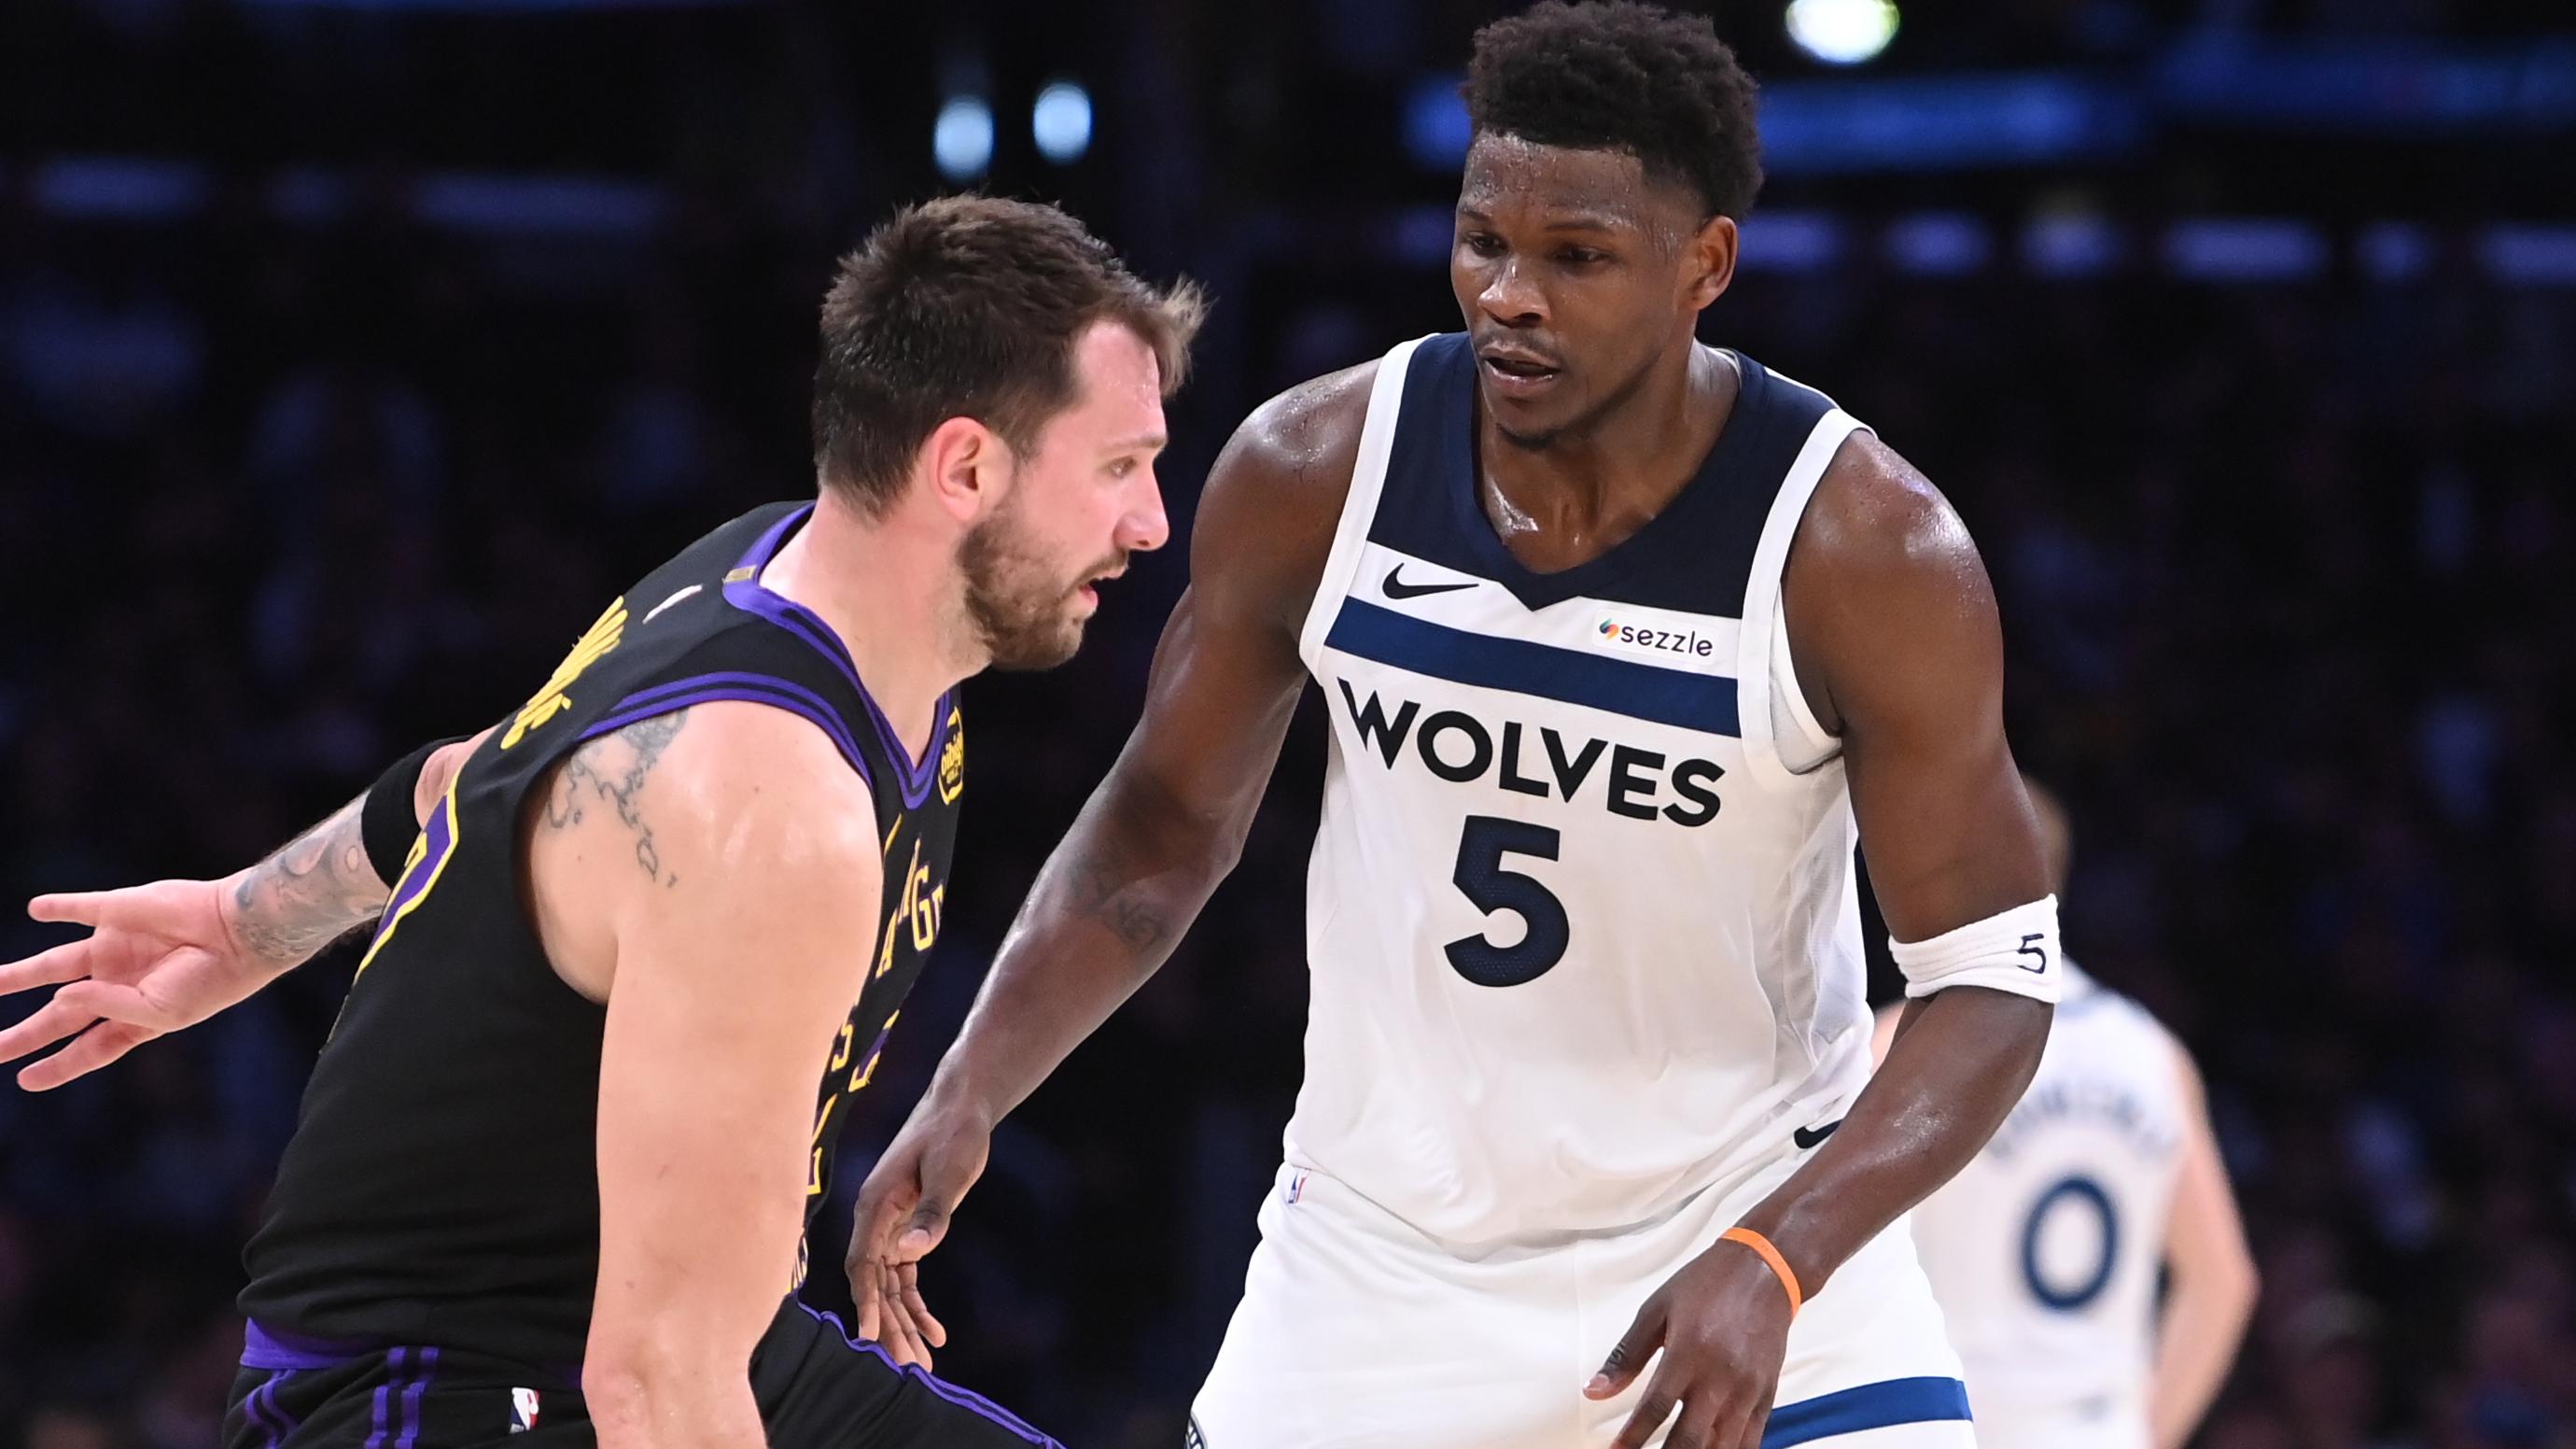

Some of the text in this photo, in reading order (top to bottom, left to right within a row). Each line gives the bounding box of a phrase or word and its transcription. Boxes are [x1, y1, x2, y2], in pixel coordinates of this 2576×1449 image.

[1620, 626, 1713, 656] sezzle
[1337, 677, 1726, 827] WOLVES
[1444, 814, 1570, 987] 5
[2017, 934, 2047, 975] 5
[2022, 1176, 2121, 1314] 0
